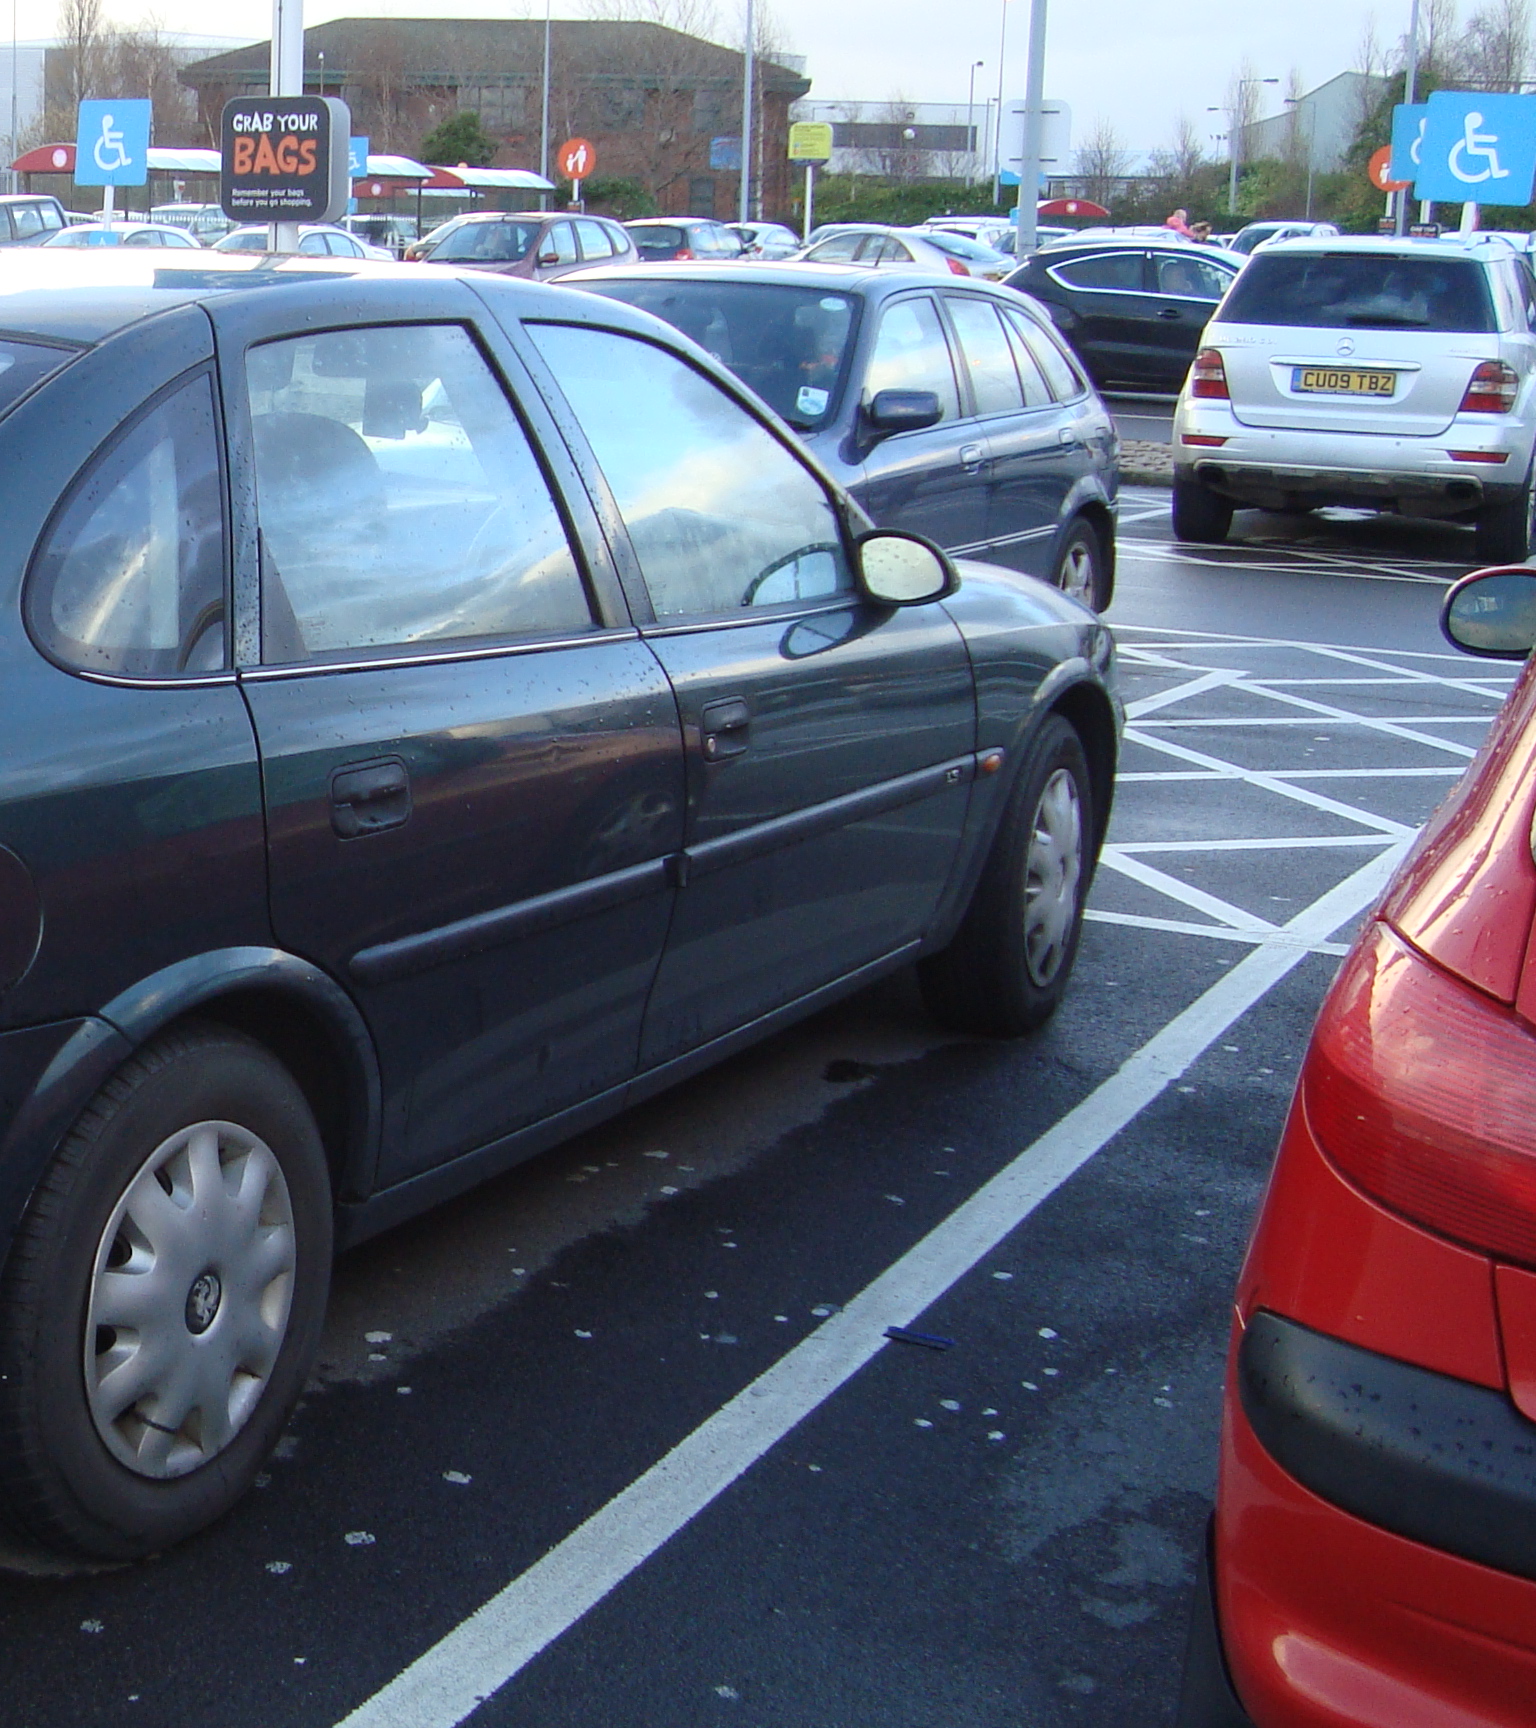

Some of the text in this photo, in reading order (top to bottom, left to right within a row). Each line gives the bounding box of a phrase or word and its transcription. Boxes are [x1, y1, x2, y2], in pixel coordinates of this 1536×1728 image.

[233, 111, 318, 132] GRAB YOUR
[233, 133, 317, 176] BAGS
[232, 188, 304, 198] Remember your bags
[232, 198, 253, 207] before
[256, 199, 268, 208] you
[270, 199, 278, 208] go
[1304, 371, 1392, 391] CU09 TBZ
